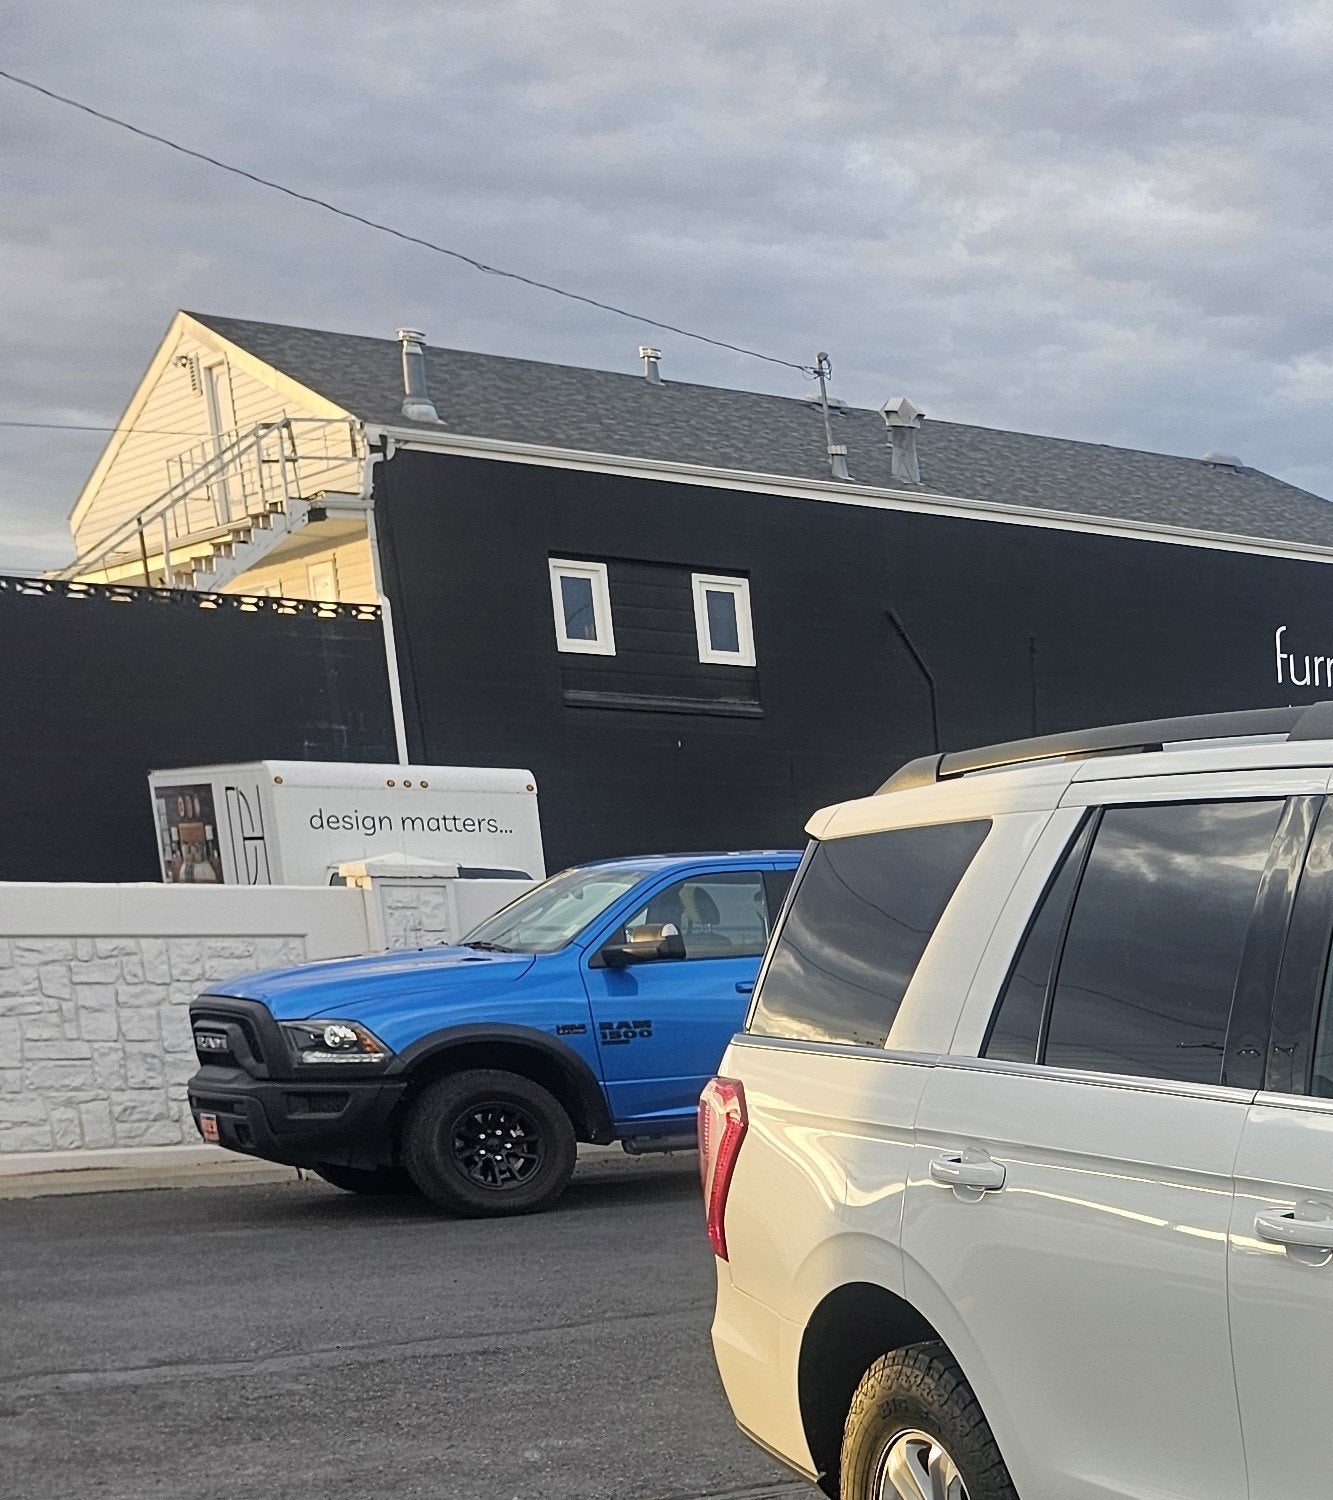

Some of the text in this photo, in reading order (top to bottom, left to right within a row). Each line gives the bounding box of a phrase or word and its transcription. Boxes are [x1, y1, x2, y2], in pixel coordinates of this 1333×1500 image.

[309, 808, 393, 837] design
[599, 1020, 652, 1030] RAM
[600, 1029, 653, 1040] 1500
